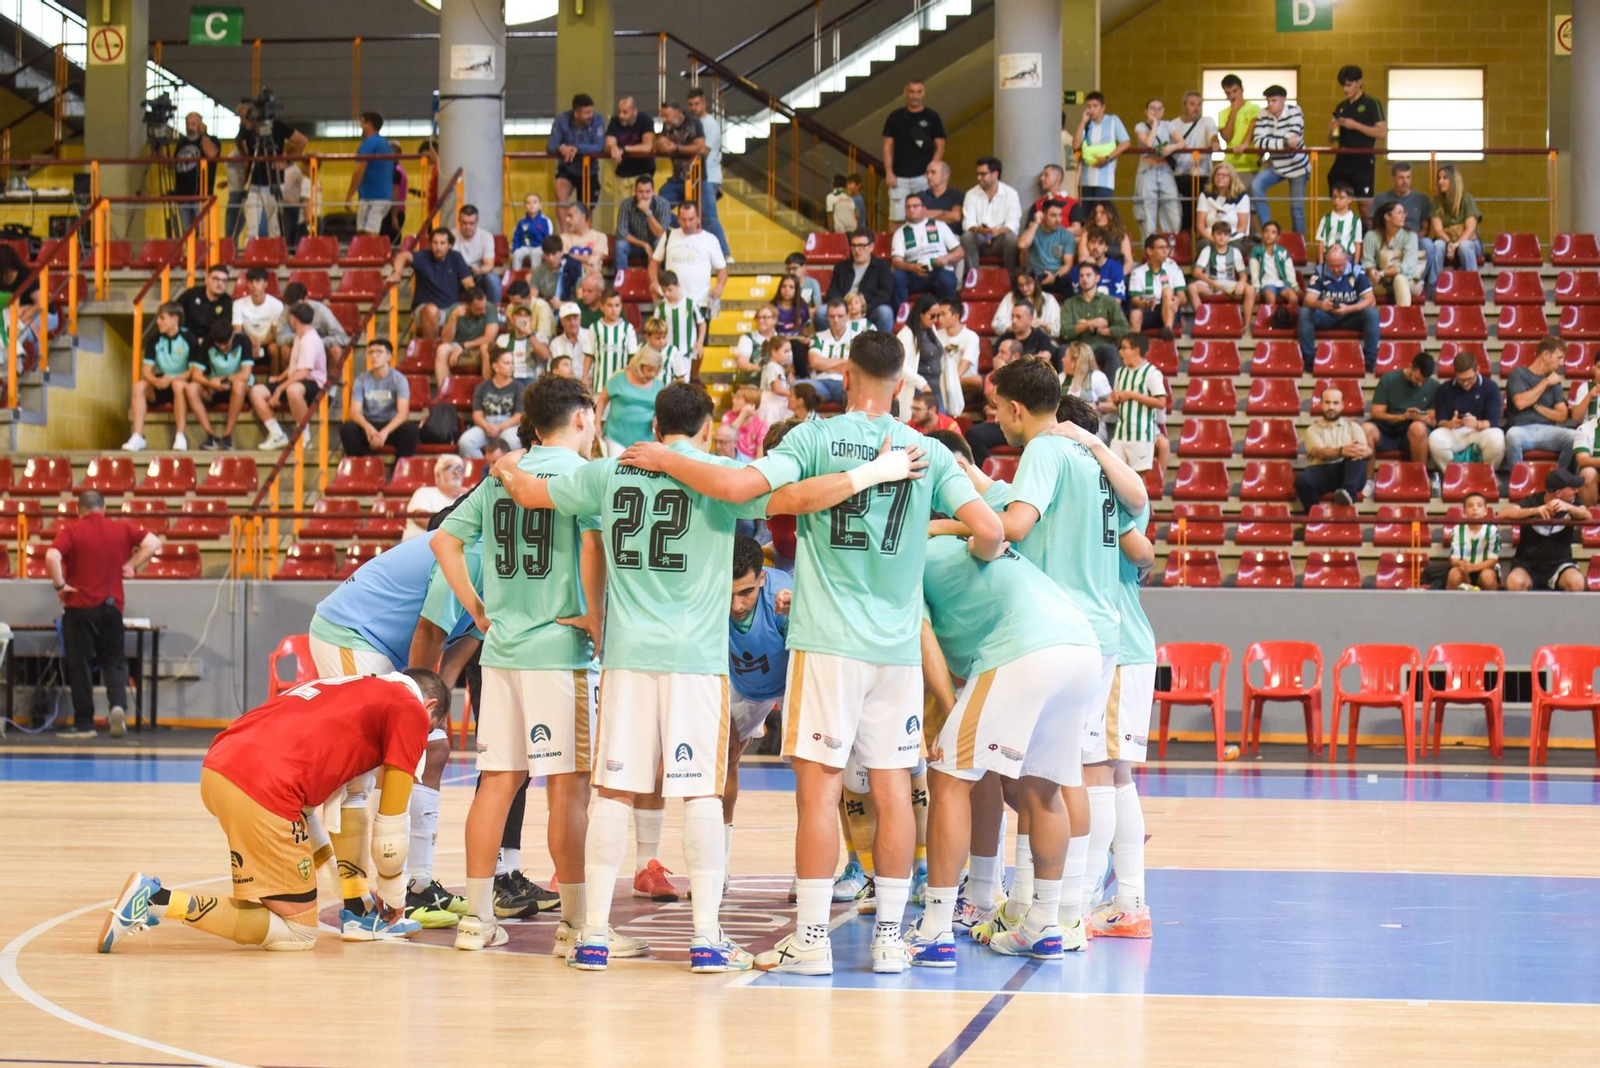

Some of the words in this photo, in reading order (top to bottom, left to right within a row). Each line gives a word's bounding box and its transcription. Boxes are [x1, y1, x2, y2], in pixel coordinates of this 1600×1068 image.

[205, 11, 228, 40] C
[1292, 0, 1316, 26] D
[493, 498, 555, 579] 99
[612, 486, 692, 572] 22
[830, 479, 913, 555] 27
